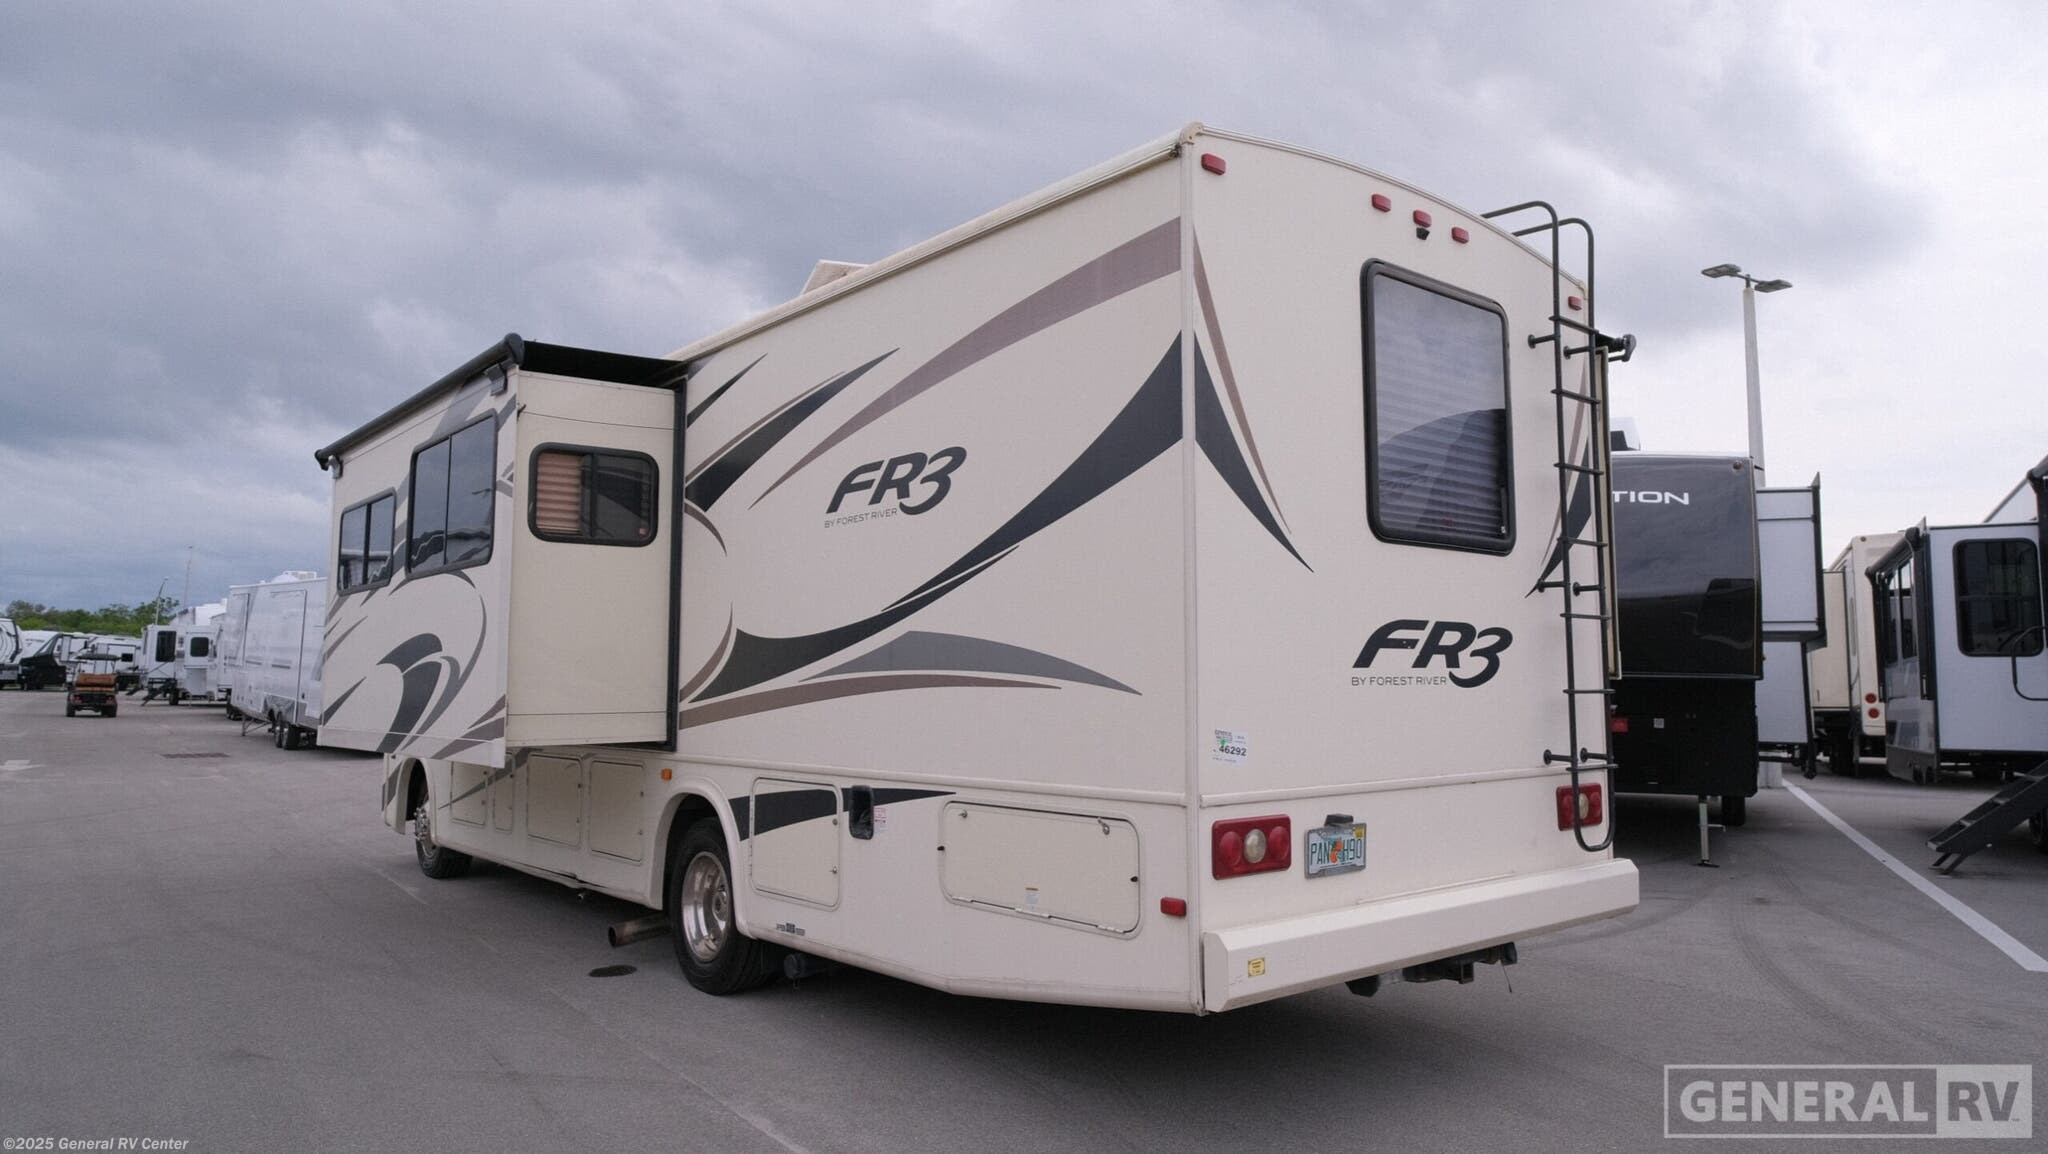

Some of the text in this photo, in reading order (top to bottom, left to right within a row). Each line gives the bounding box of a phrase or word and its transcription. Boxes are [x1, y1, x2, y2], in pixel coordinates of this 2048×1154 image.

[826, 446, 967, 515] FR3
[824, 508, 898, 528] BY FOREST RIVER
[1352, 619, 1513, 688] FR3
[1351, 676, 1447, 686] BY FOREST RIVER
[1219, 745, 1247, 756] 46292
[1310, 842, 1330, 864] PAN
